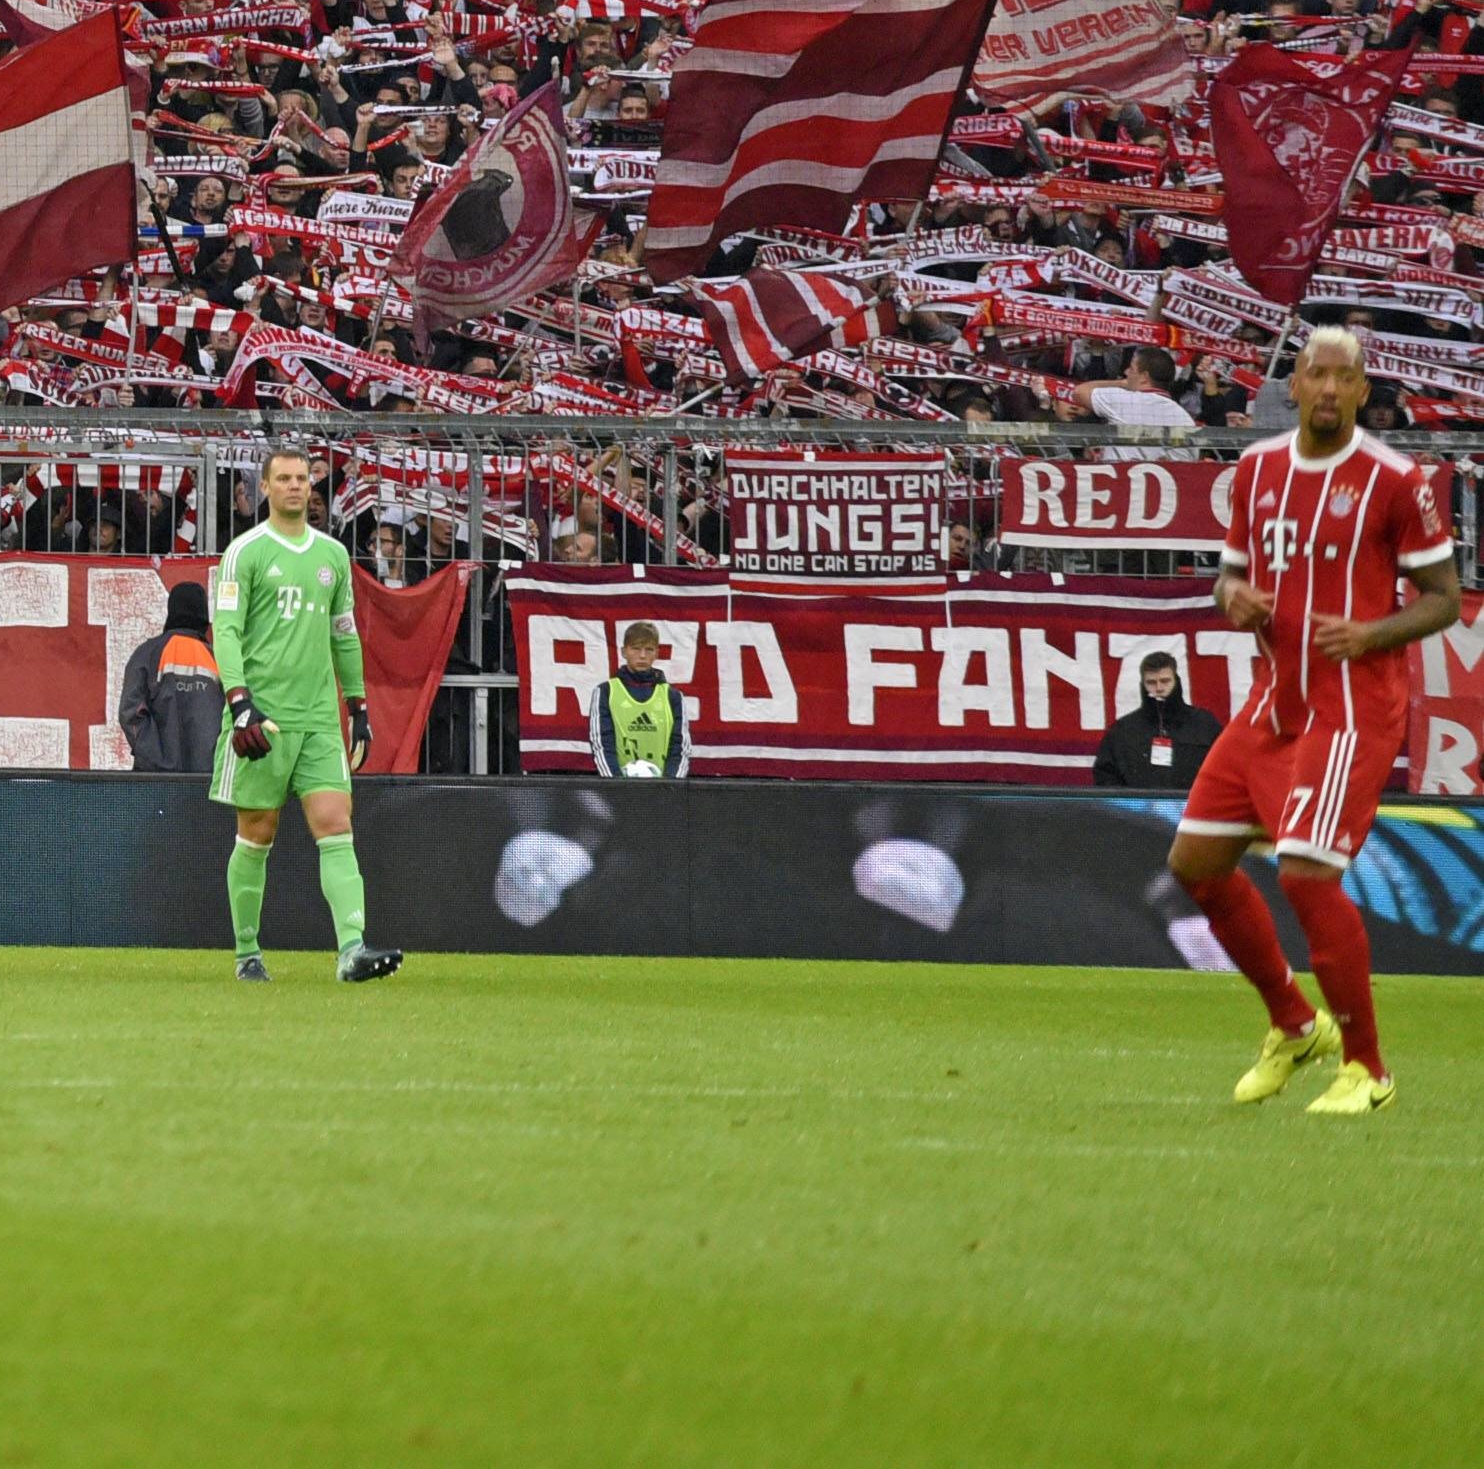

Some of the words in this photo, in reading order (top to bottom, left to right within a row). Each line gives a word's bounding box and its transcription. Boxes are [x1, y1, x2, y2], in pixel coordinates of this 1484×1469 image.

[1019, 461, 1179, 530] RED
[736, 502, 943, 554] JUNGS!
[734, 553, 761, 572] NO
[765, 553, 806, 572] ONE
[811, 553, 849, 572] CAN
[853, 554, 907, 572] STOP
[910, 554, 937, 573] US
